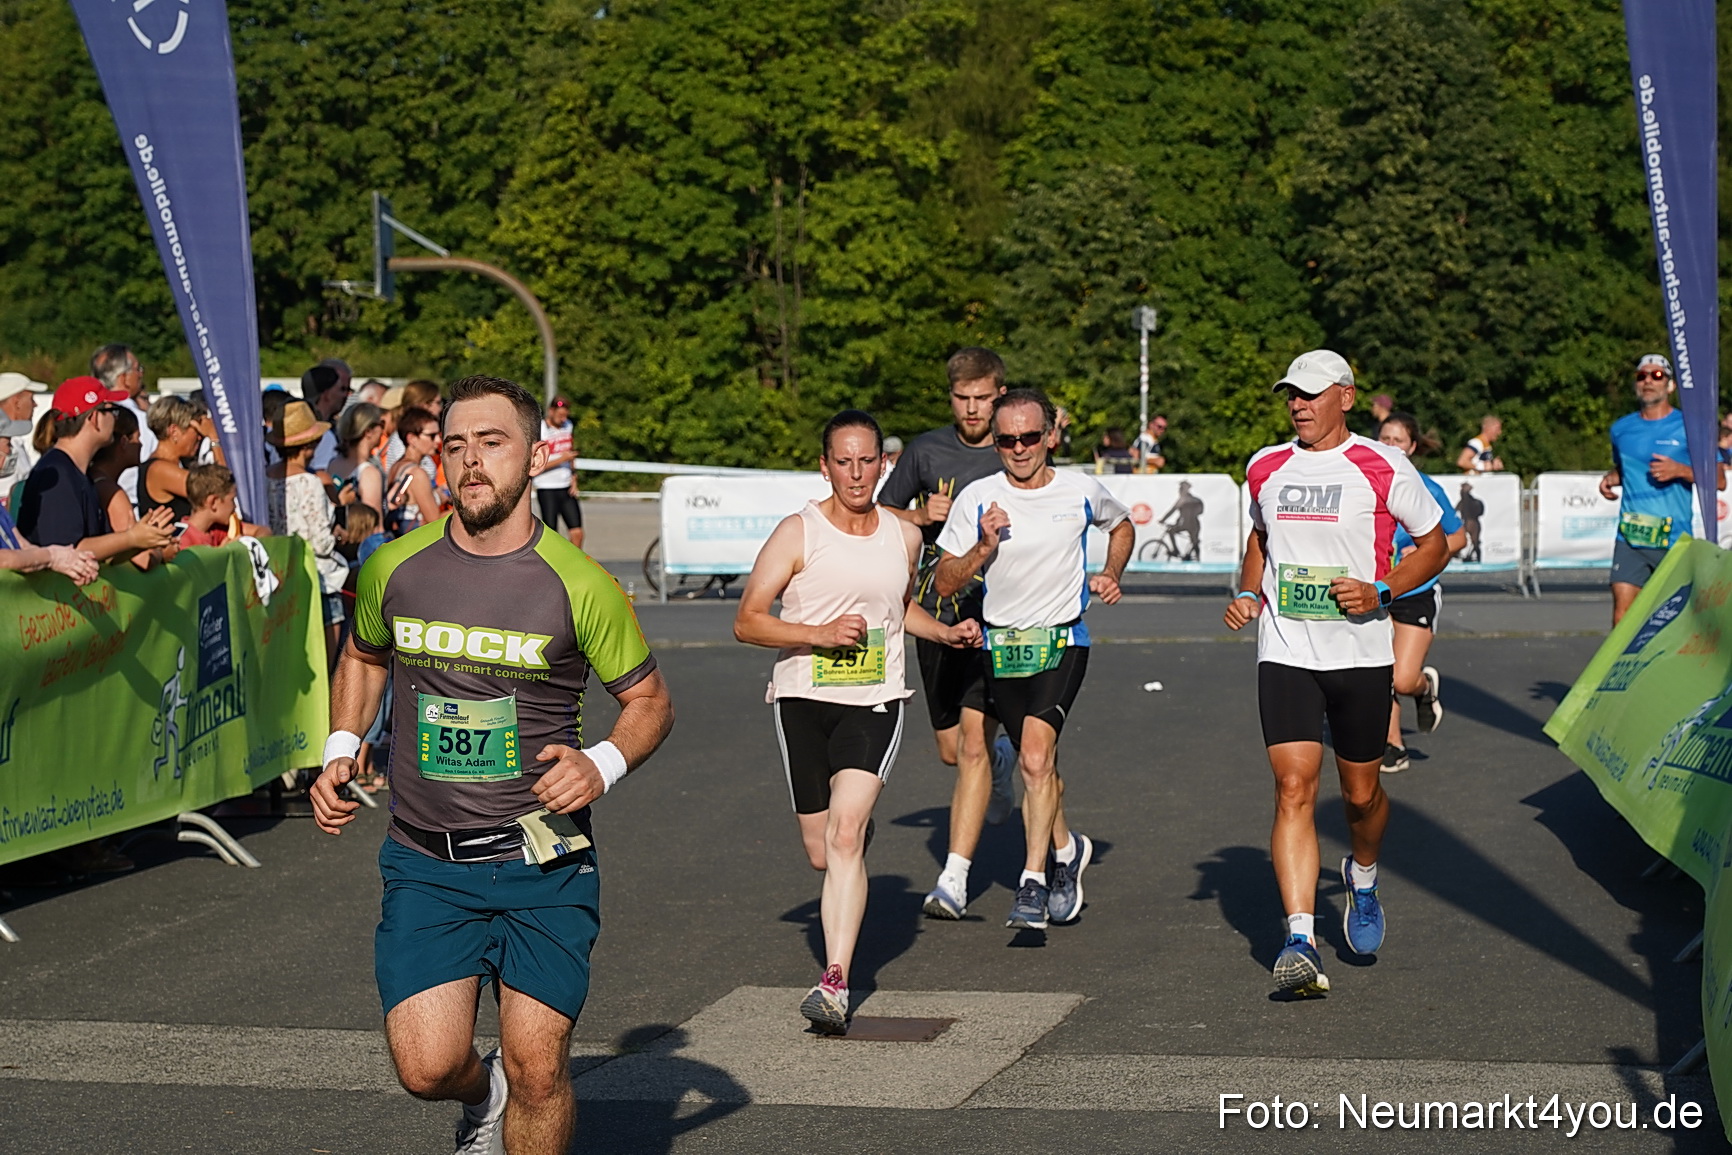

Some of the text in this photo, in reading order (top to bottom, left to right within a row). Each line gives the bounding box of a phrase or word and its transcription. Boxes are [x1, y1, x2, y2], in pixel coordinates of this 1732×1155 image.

[686, 496, 721, 508] NOW
[1277, 484, 1343, 507] OM
[1562, 495, 1598, 508] NOW
[1294, 583, 1330, 602] 507
[1310, 602, 1329, 610] Klaus
[395, 620, 547, 667] BOCK
[1006, 645, 1033, 661] 315
[831, 649, 869, 668] 257
[434, 658, 450, 673] by
[453, 662, 491, 676] smart
[495, 668, 550, 682] concepts
[421, 732, 430, 762] RUN
[438, 726, 492, 756] 587
[504, 730, 517, 768] 2022
[435, 755, 496, 767] Witas Adam
